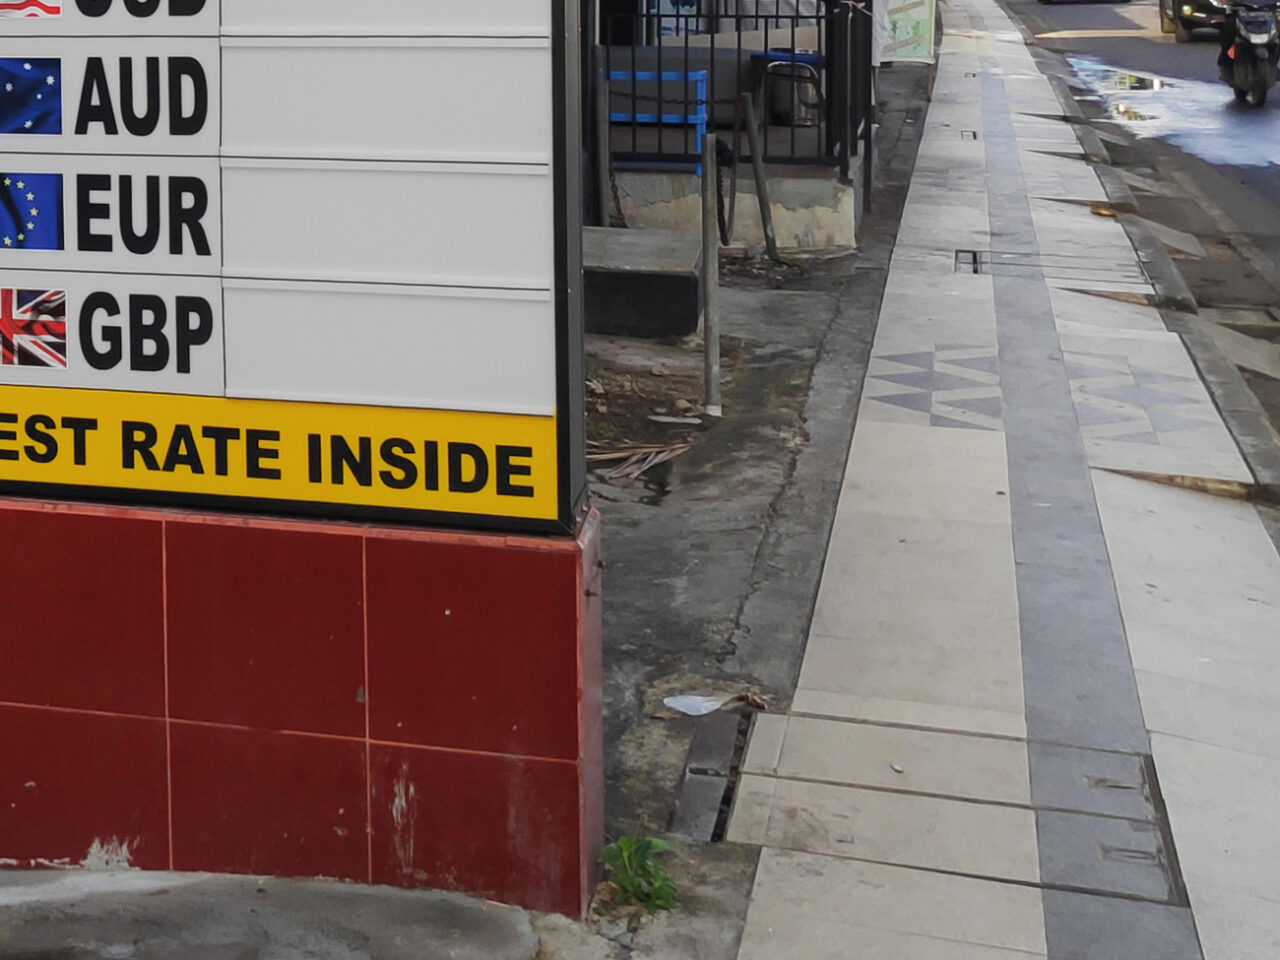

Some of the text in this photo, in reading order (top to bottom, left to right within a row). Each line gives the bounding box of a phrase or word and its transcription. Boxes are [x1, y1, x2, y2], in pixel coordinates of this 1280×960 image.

[73, 55, 209, 137] AUD
[76, 172, 212, 256] EUR
[77, 290, 214, 374] GBP
[120, 420, 282, 480] RATE
[307, 432, 535, 497] INSIDE
